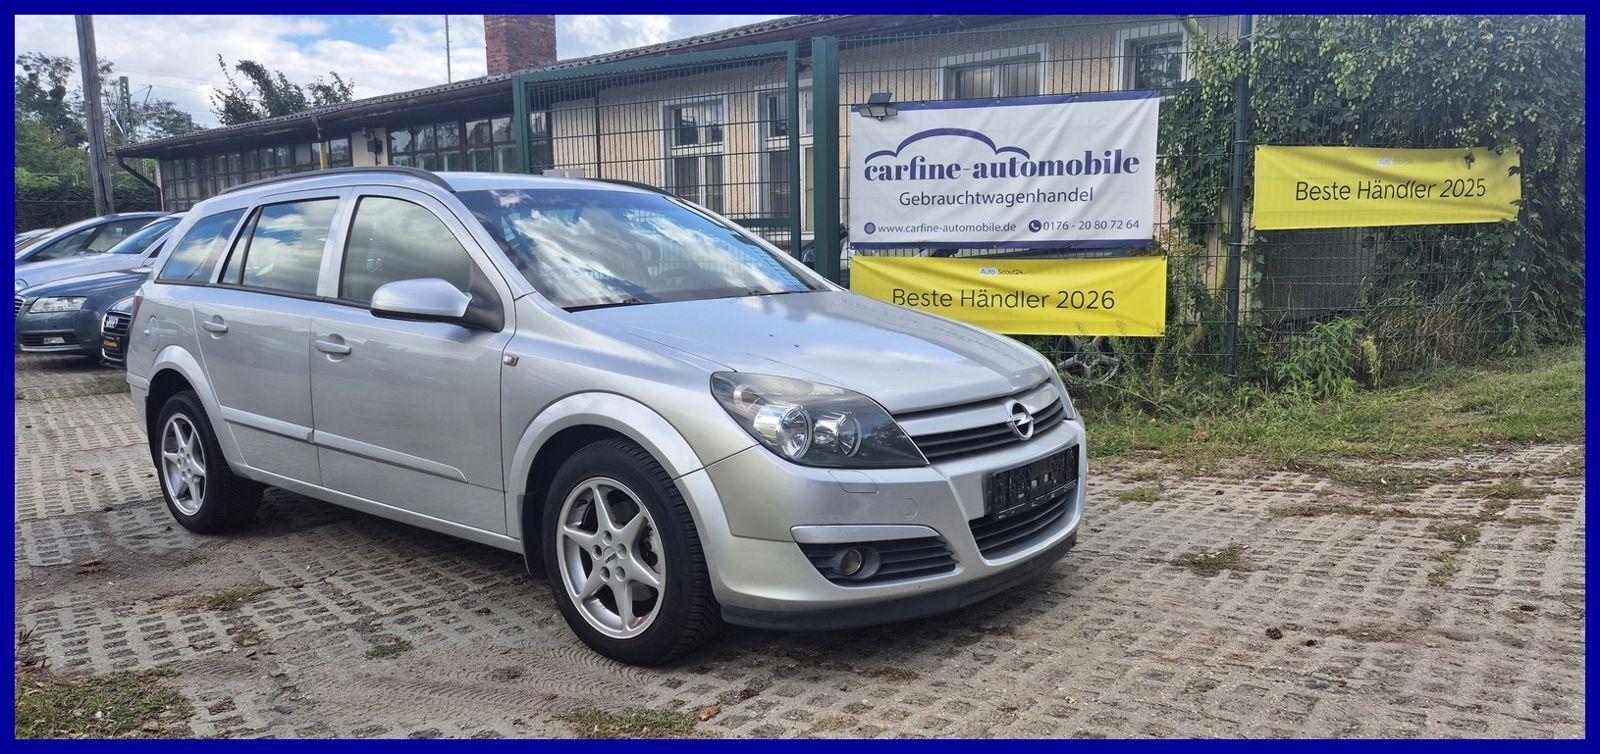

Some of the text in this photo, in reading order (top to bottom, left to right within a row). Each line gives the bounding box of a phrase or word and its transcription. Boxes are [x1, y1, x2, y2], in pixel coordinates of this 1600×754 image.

[864, 149, 1140, 181] carfine-automobile
[899, 187, 1094, 207] Gebrauchtwagenhandel
[1296, 178, 1486, 201] Beste Händler 2025
[878, 222, 1017, 233] www.carfine-automobile.de
[1043, 221, 1069, 231] 0176
[1078, 220, 1092, 230] 20
[1094, 220, 1108, 230] 80
[1110, 220, 1123, 230] 72
[1126, 219, 1140, 229] 64
[892, 288, 1115, 310] Beste Händler 2026
